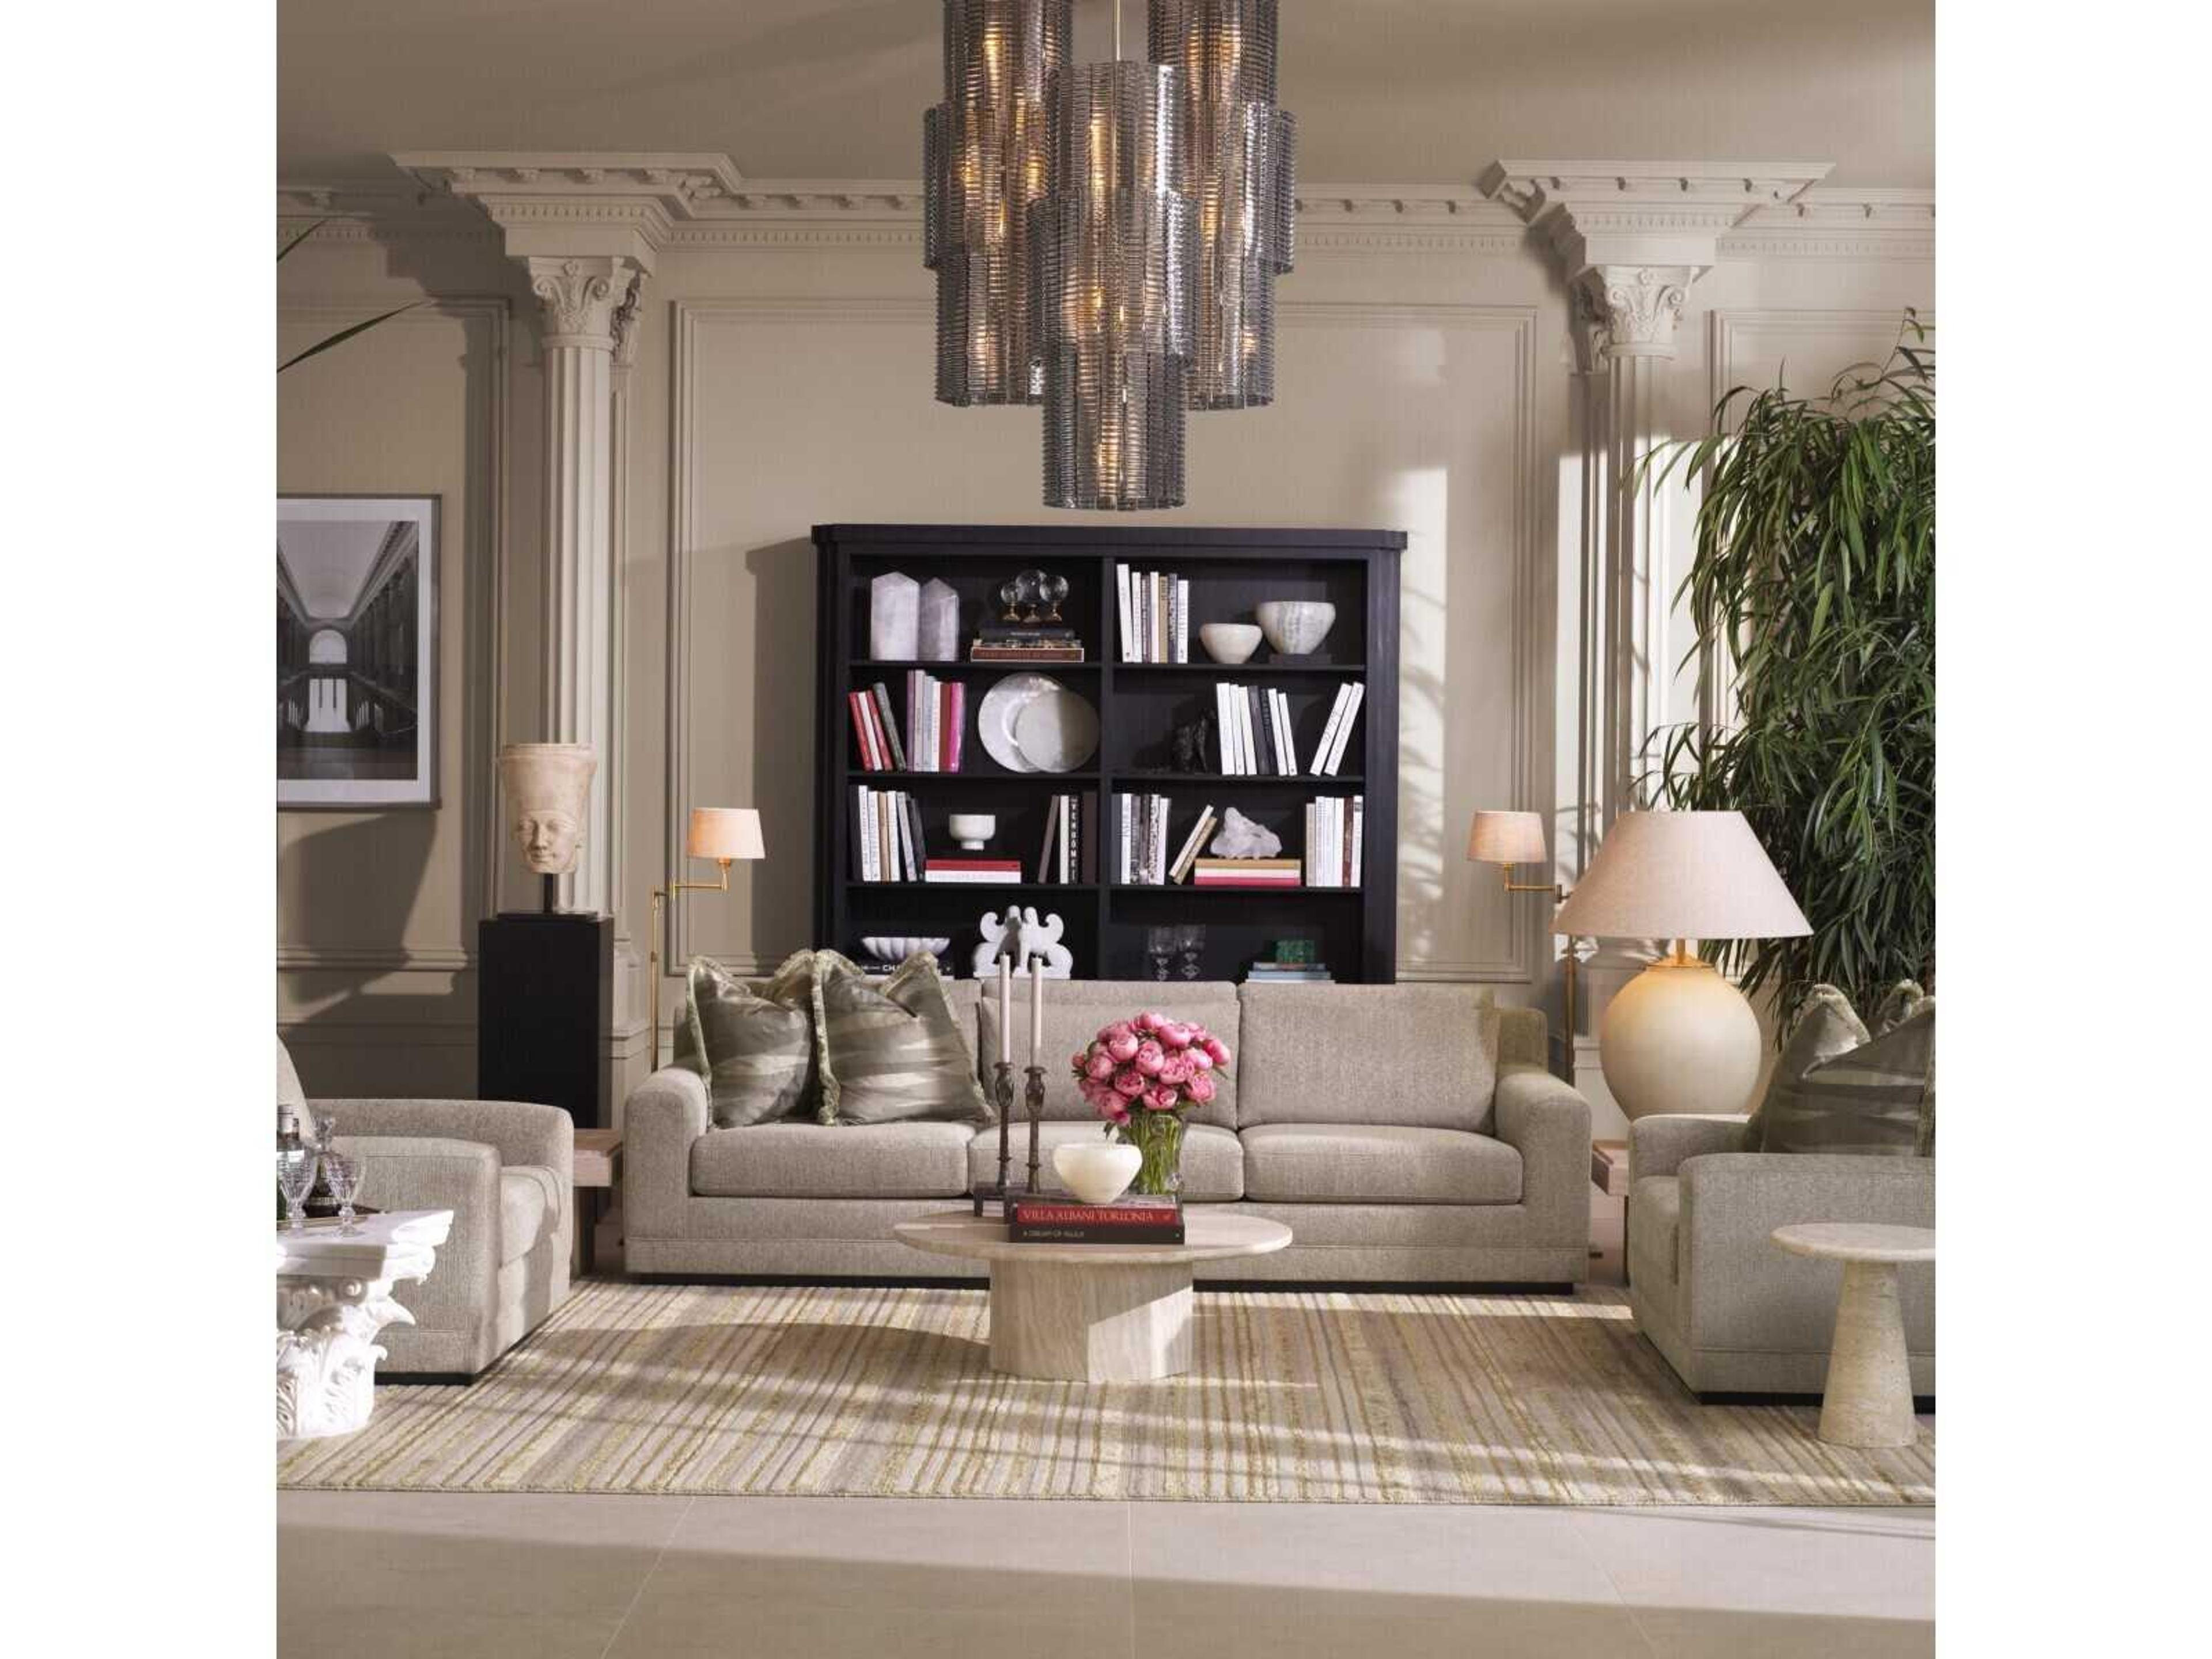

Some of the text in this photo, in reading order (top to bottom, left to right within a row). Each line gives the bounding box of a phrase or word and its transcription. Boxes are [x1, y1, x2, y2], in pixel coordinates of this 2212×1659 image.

[1023, 1209, 1153, 1222] VILLA ALBANI TORLONIA
